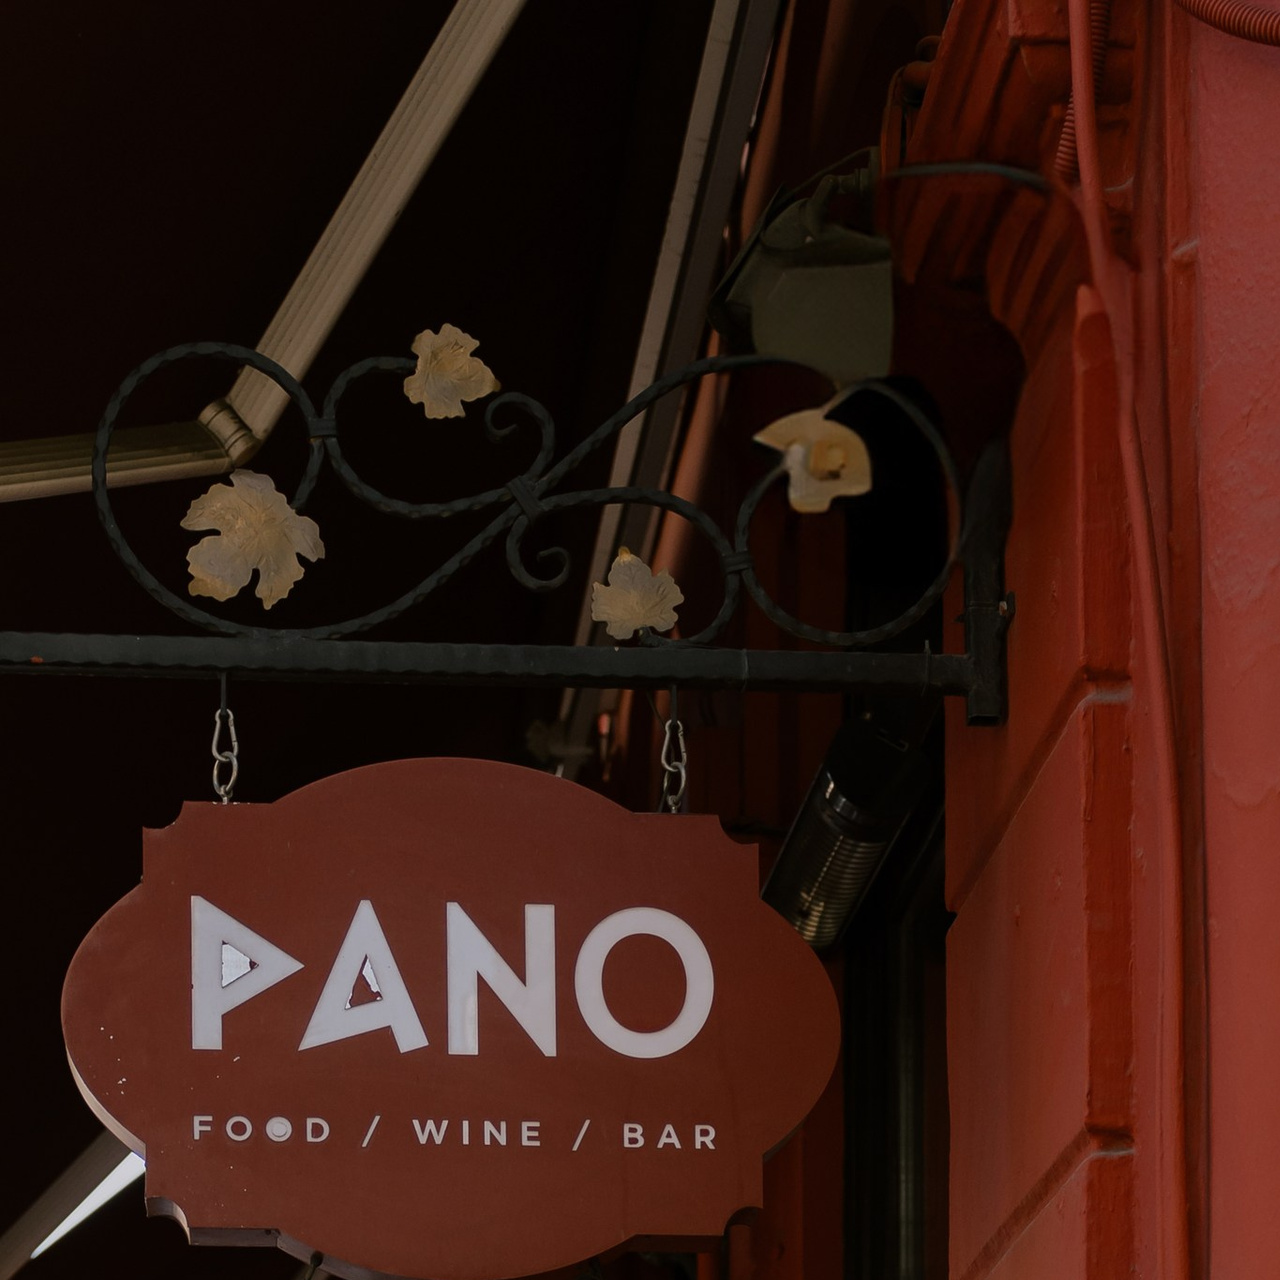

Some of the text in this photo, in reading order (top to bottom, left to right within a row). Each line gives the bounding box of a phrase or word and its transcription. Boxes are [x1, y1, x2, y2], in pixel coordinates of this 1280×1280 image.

[190, 895, 715, 1059] PANO
[193, 1115, 330, 1143] FOOD
[411, 1118, 541, 1147] WINE
[623, 1123, 716, 1150] BAR
